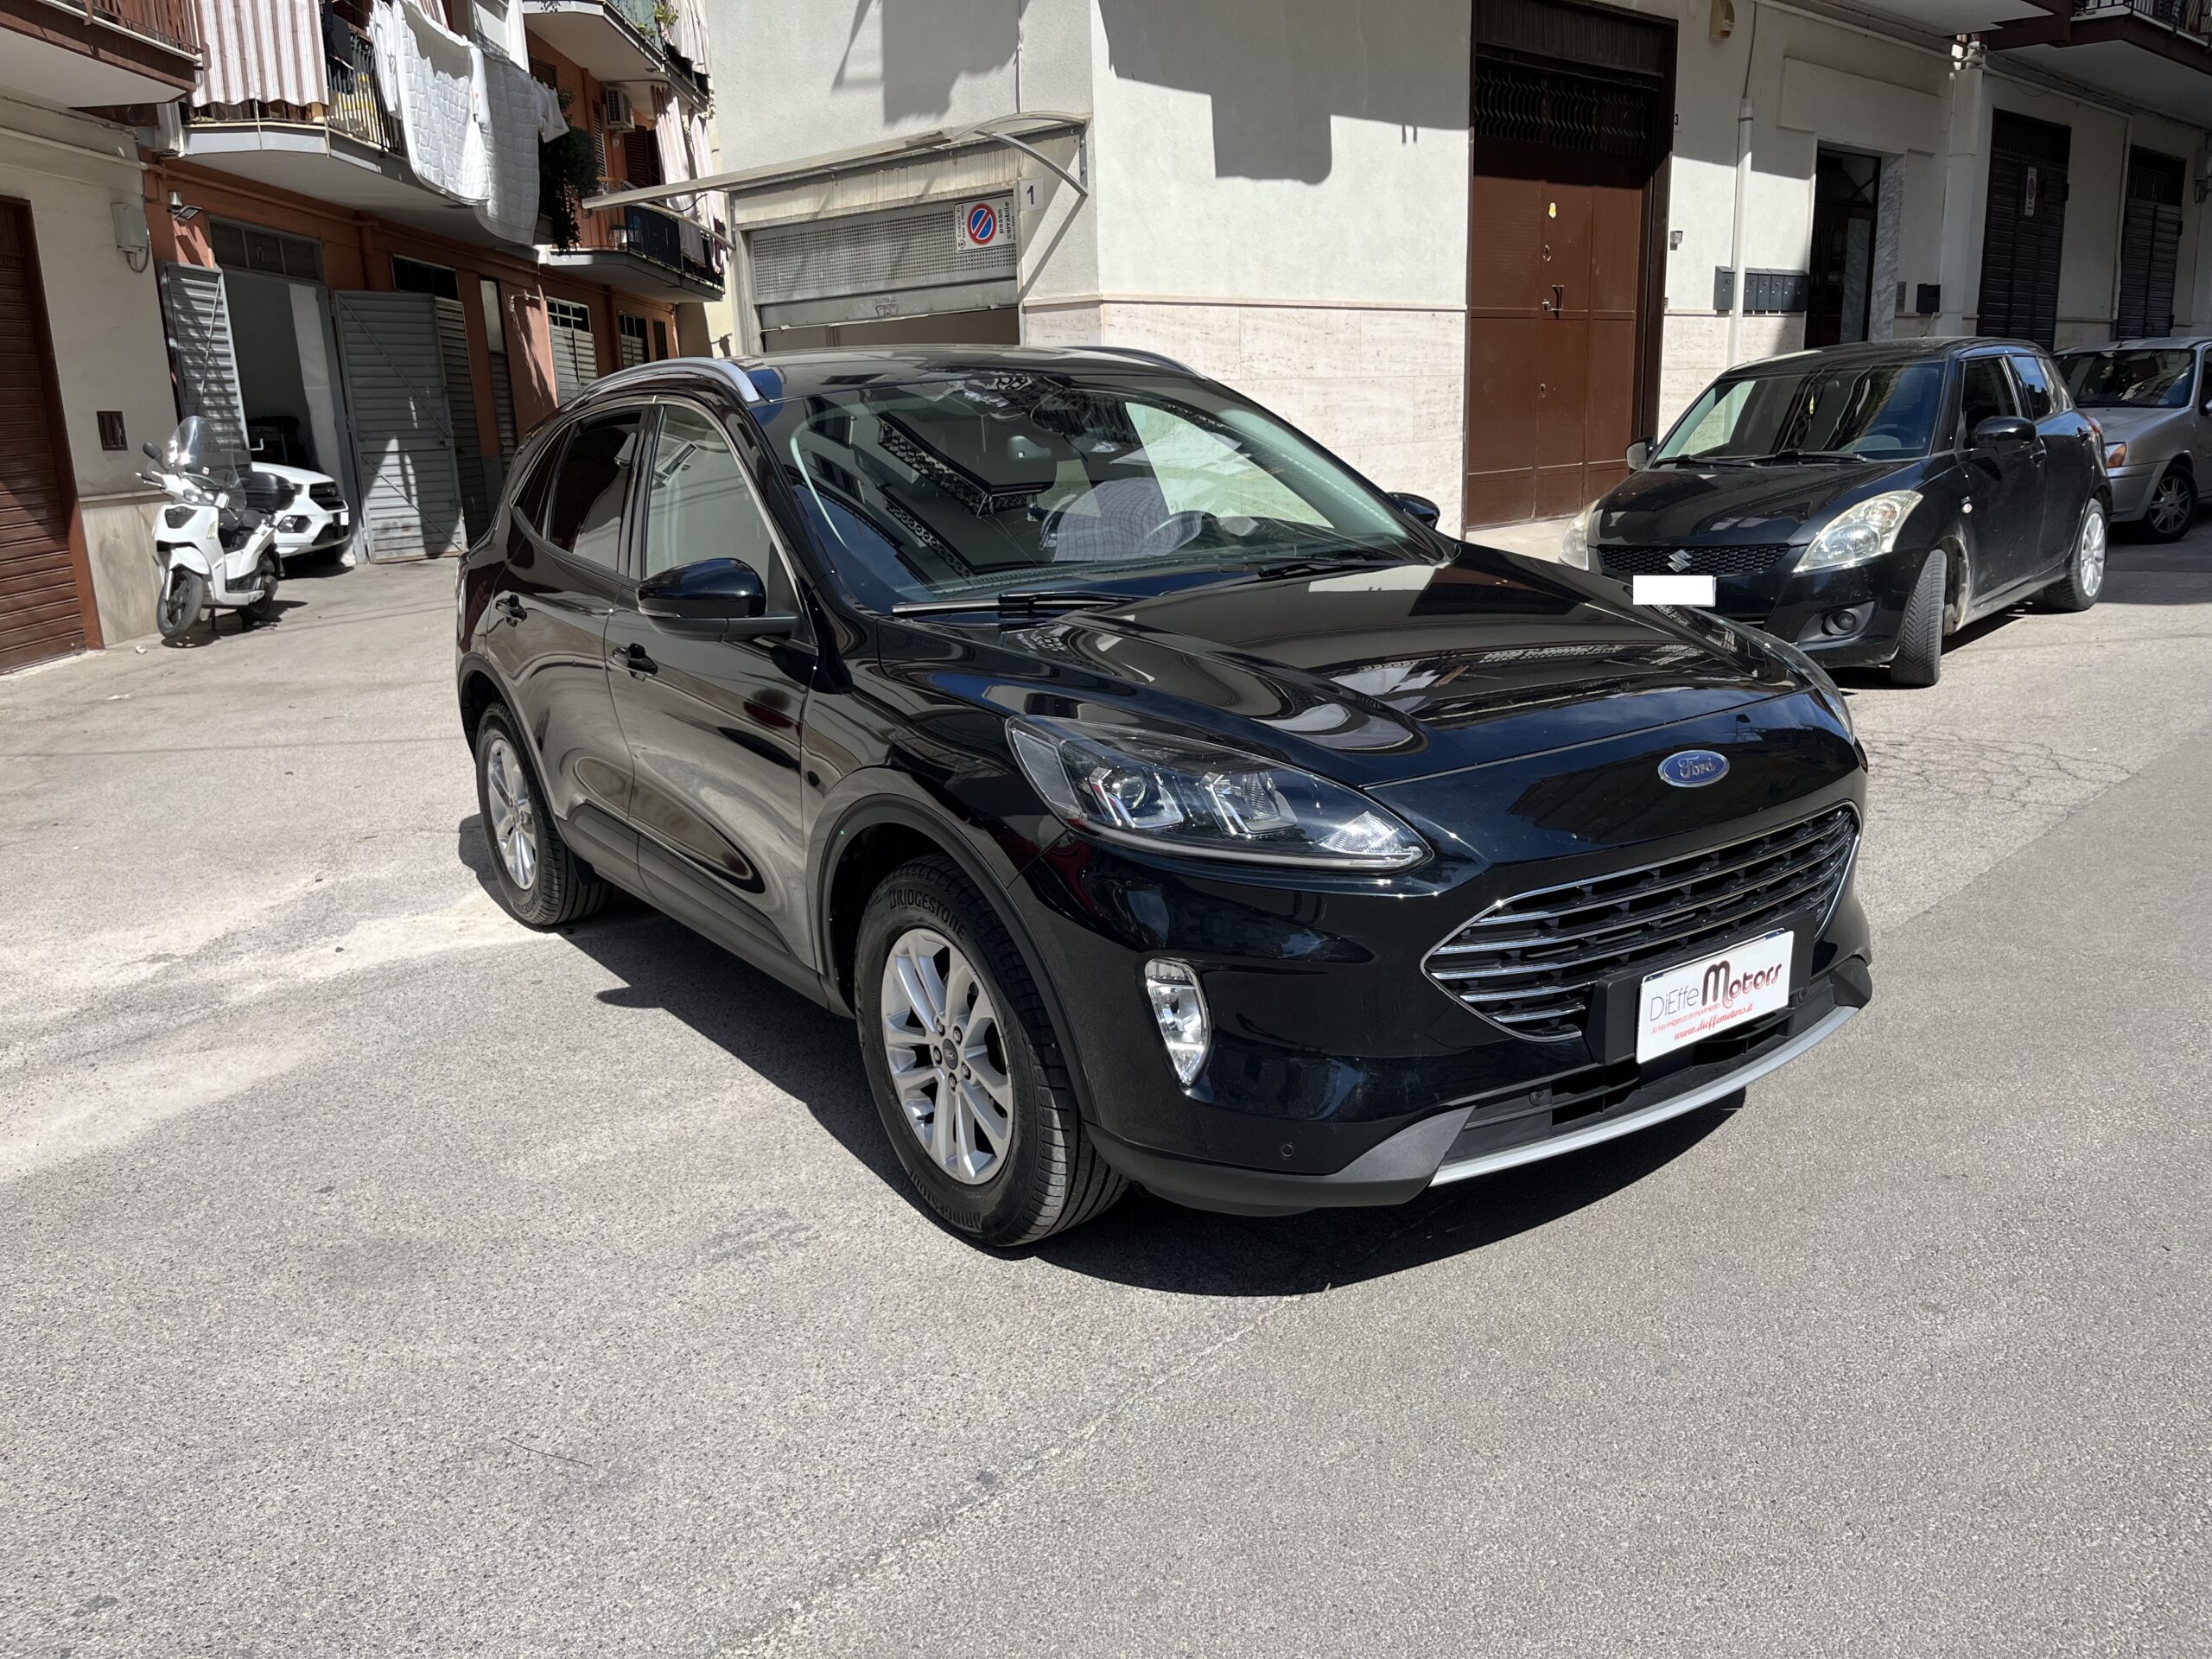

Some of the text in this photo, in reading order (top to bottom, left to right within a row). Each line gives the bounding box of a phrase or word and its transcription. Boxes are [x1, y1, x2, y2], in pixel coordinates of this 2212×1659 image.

[1027, 185, 1035, 205] 1
[1677, 755, 1716, 779] Ford
[1650, 960, 1783, 1021] DiEffe Motors
